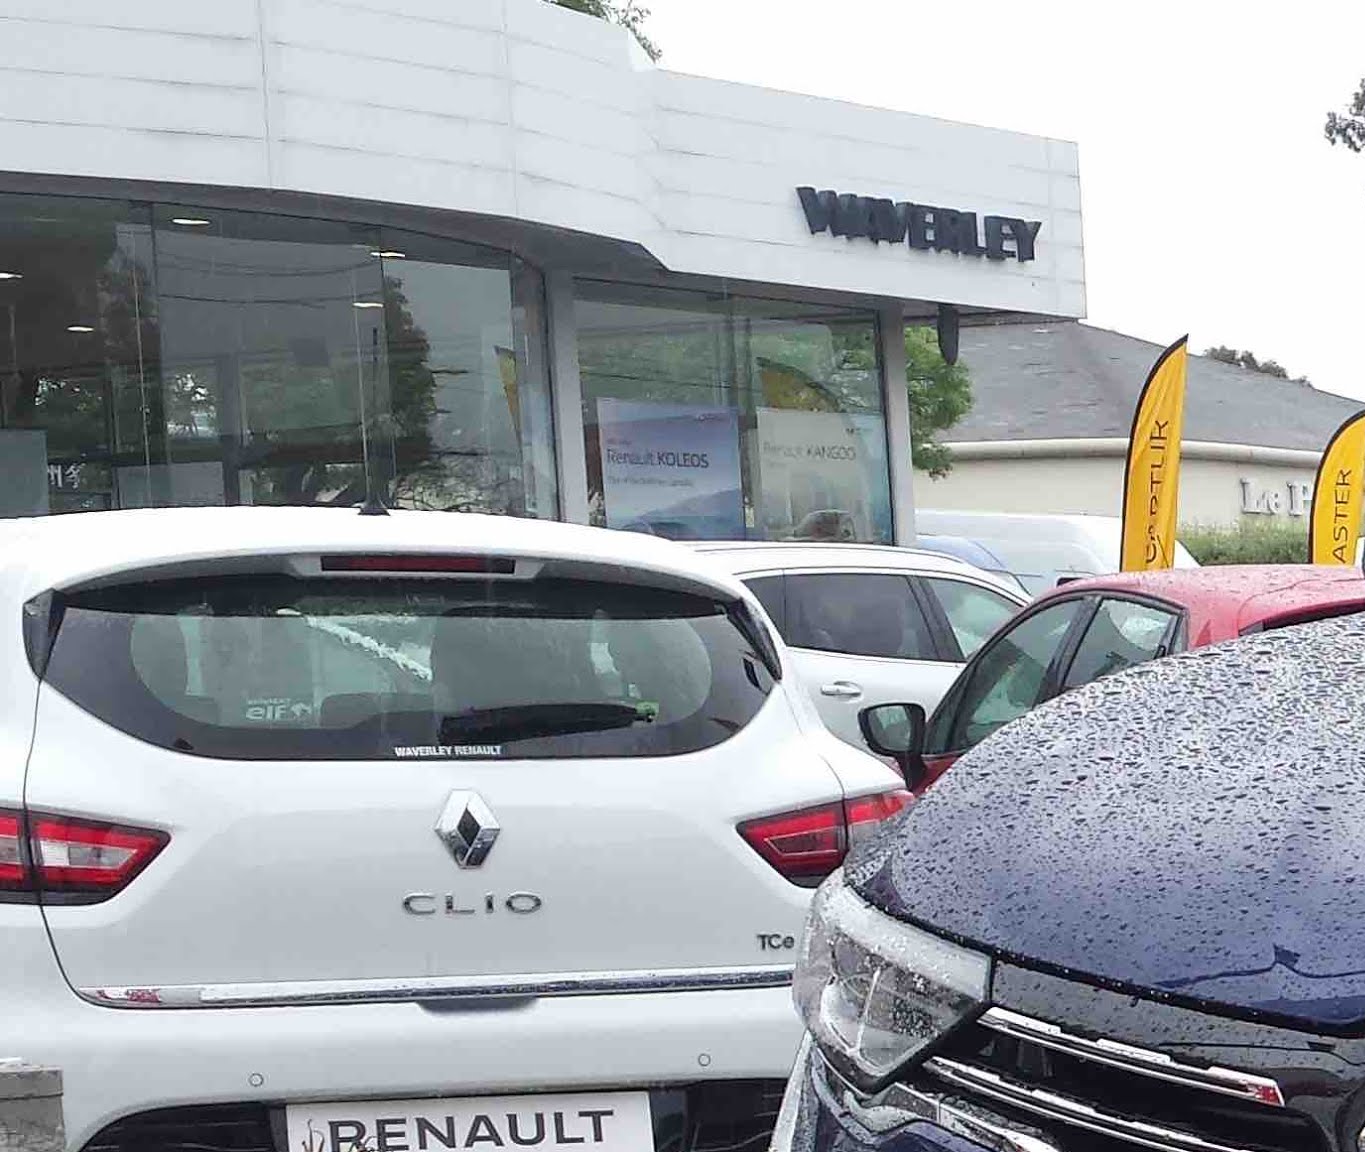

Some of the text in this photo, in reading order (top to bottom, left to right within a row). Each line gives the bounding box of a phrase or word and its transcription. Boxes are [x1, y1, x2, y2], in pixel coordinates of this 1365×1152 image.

[796, 186, 1042, 263] WAVERLEY
[658, 452, 710, 469] KOLEOS
[245, 705, 287, 720] elf
[394, 745, 502, 757] WAVERLEY RENAULT
[403, 893, 543, 915] CLIO
[757, 933, 795, 951] TCe
